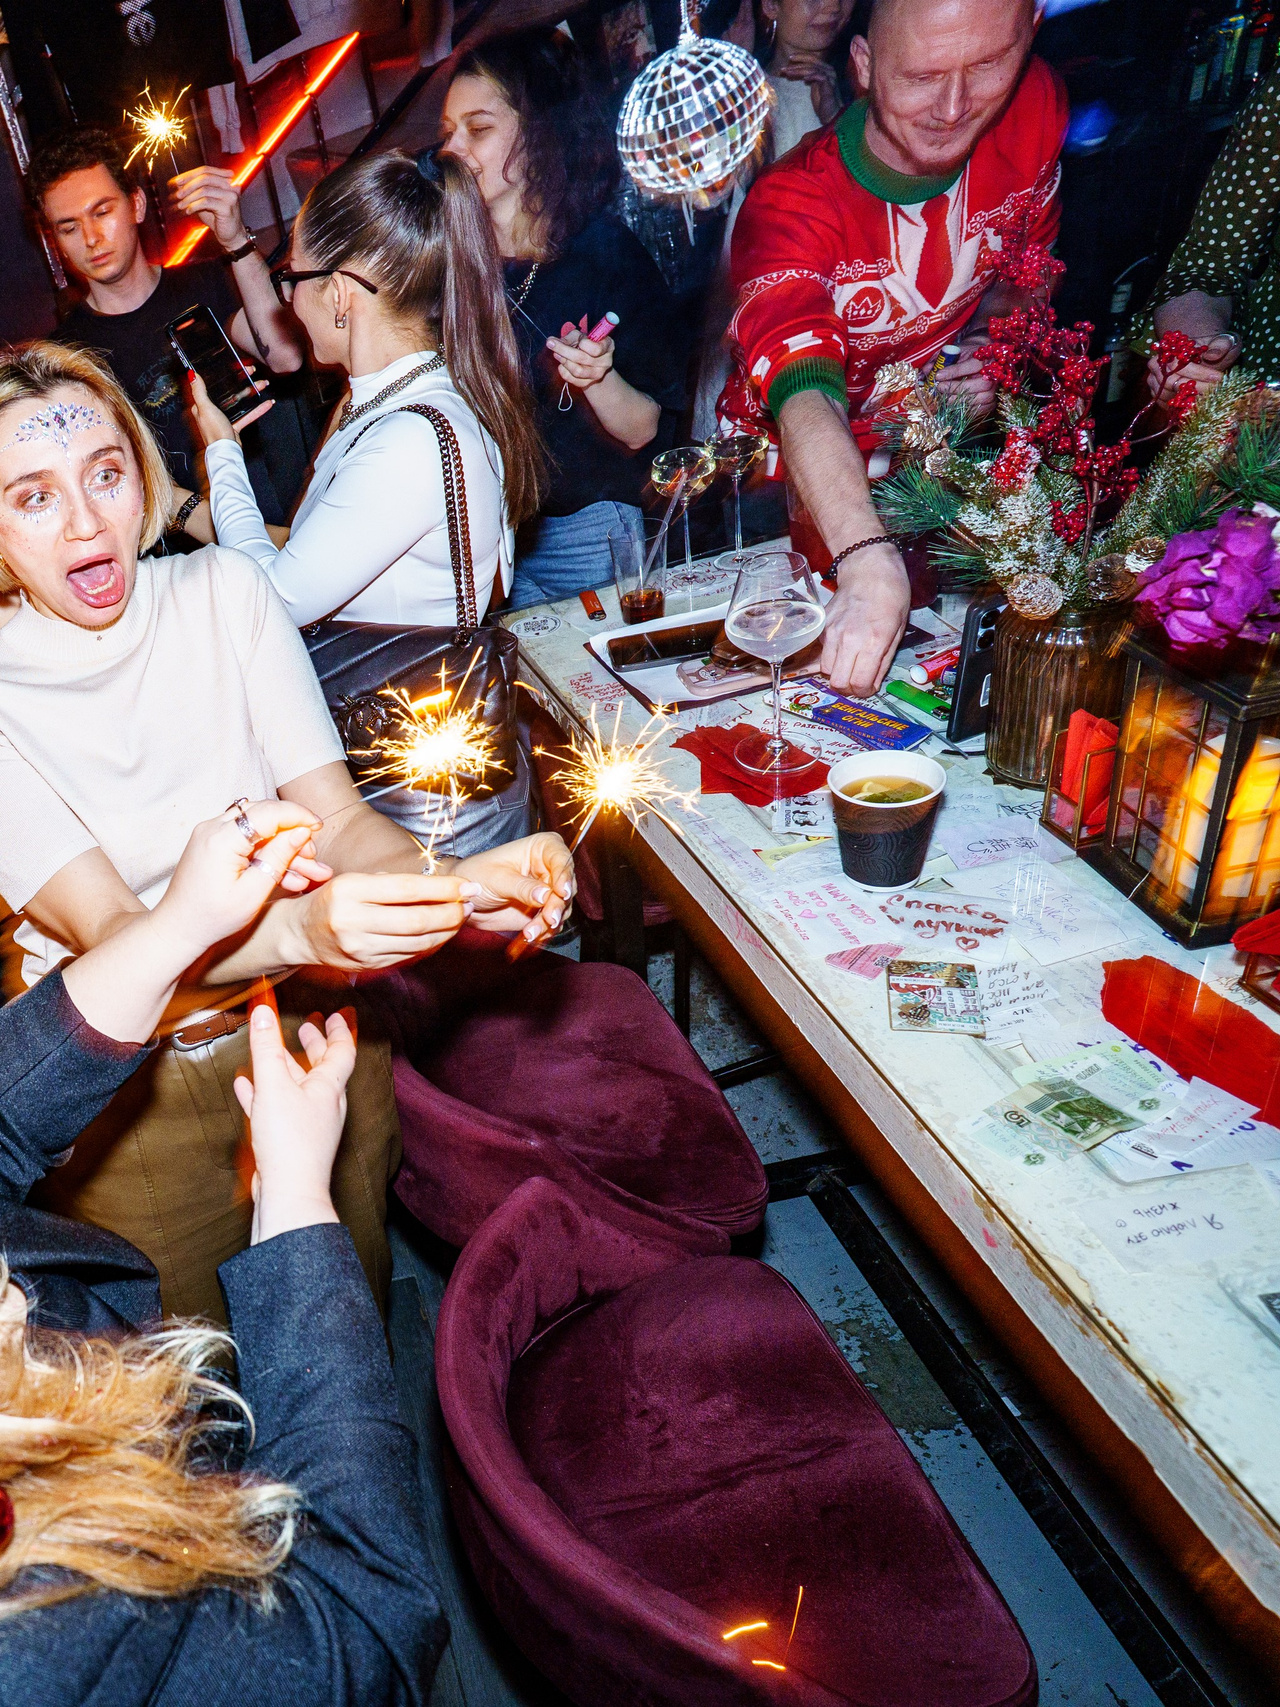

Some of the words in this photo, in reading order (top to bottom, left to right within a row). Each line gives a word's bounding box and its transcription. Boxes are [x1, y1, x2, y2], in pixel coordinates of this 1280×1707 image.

[831, 702, 910, 731] БЕНГАЛЬСКИЕ
[841, 715, 874, 730] ОГНИ
[1003, 1110, 1032, 1128] 5
[1202, 1213, 1224, 1231] Я
